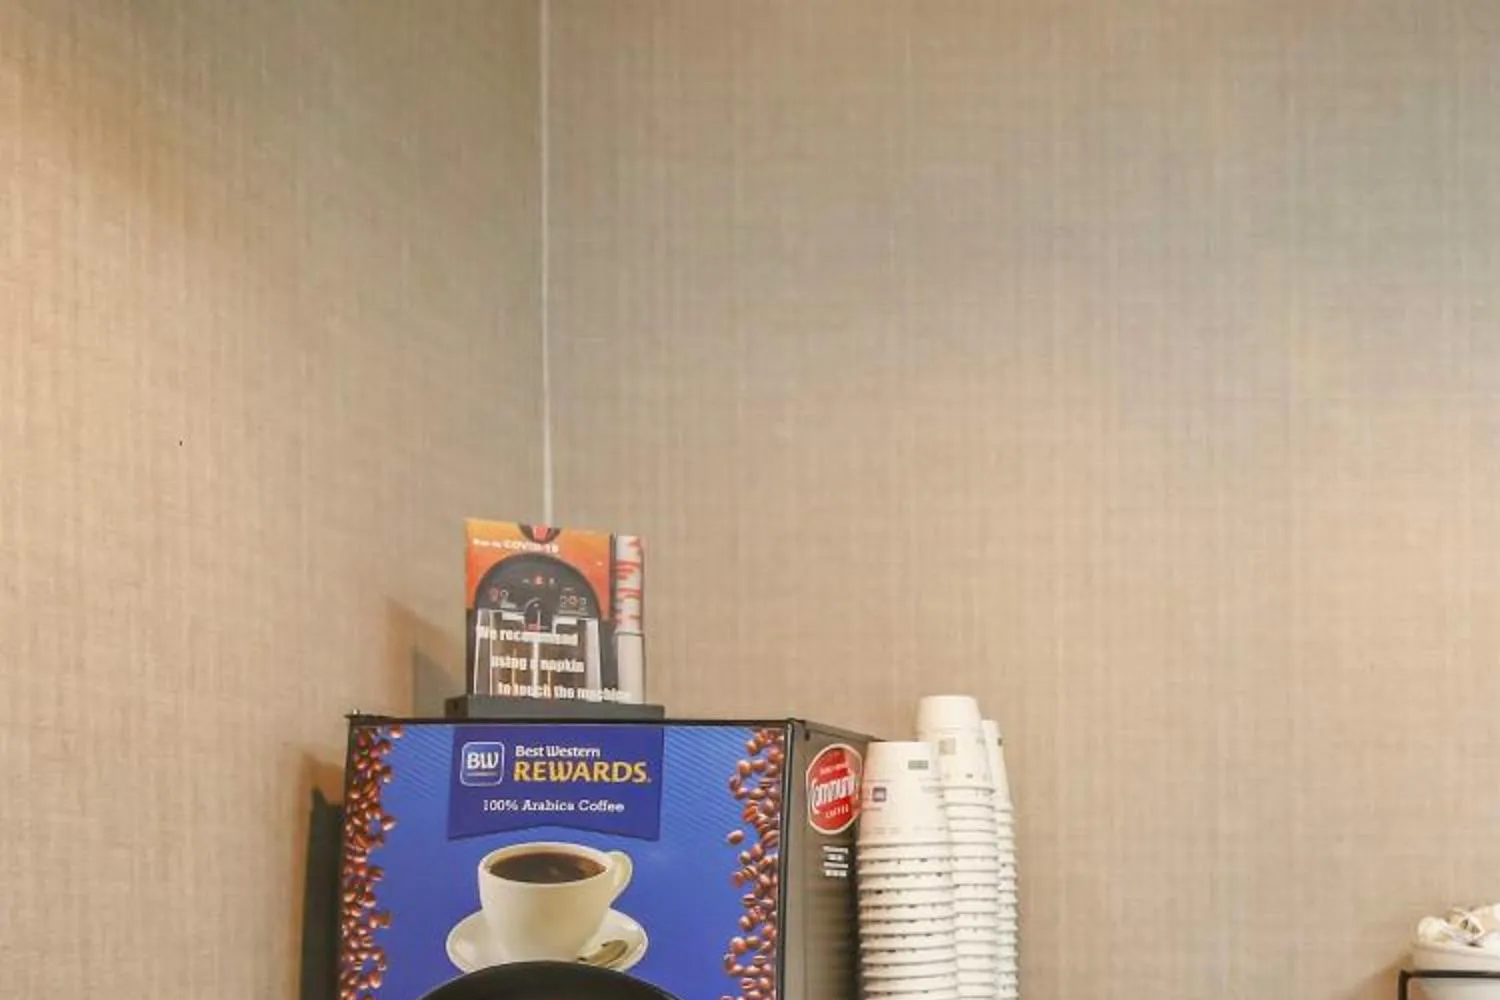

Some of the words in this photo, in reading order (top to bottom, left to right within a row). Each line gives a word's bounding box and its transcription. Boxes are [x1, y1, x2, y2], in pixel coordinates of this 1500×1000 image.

[492, 655, 527, 670] using
[540, 657, 584, 672] napkin
[554, 684, 574, 698] the
[515, 746, 544, 757] Best
[546, 746, 600, 758] Western
[466, 752, 499, 769] BW
[513, 761, 647, 783] REWARDS
[483, 800, 518, 811] 100%
[522, 799, 575, 812] Arabica
[579, 799, 625, 813] Coffee
